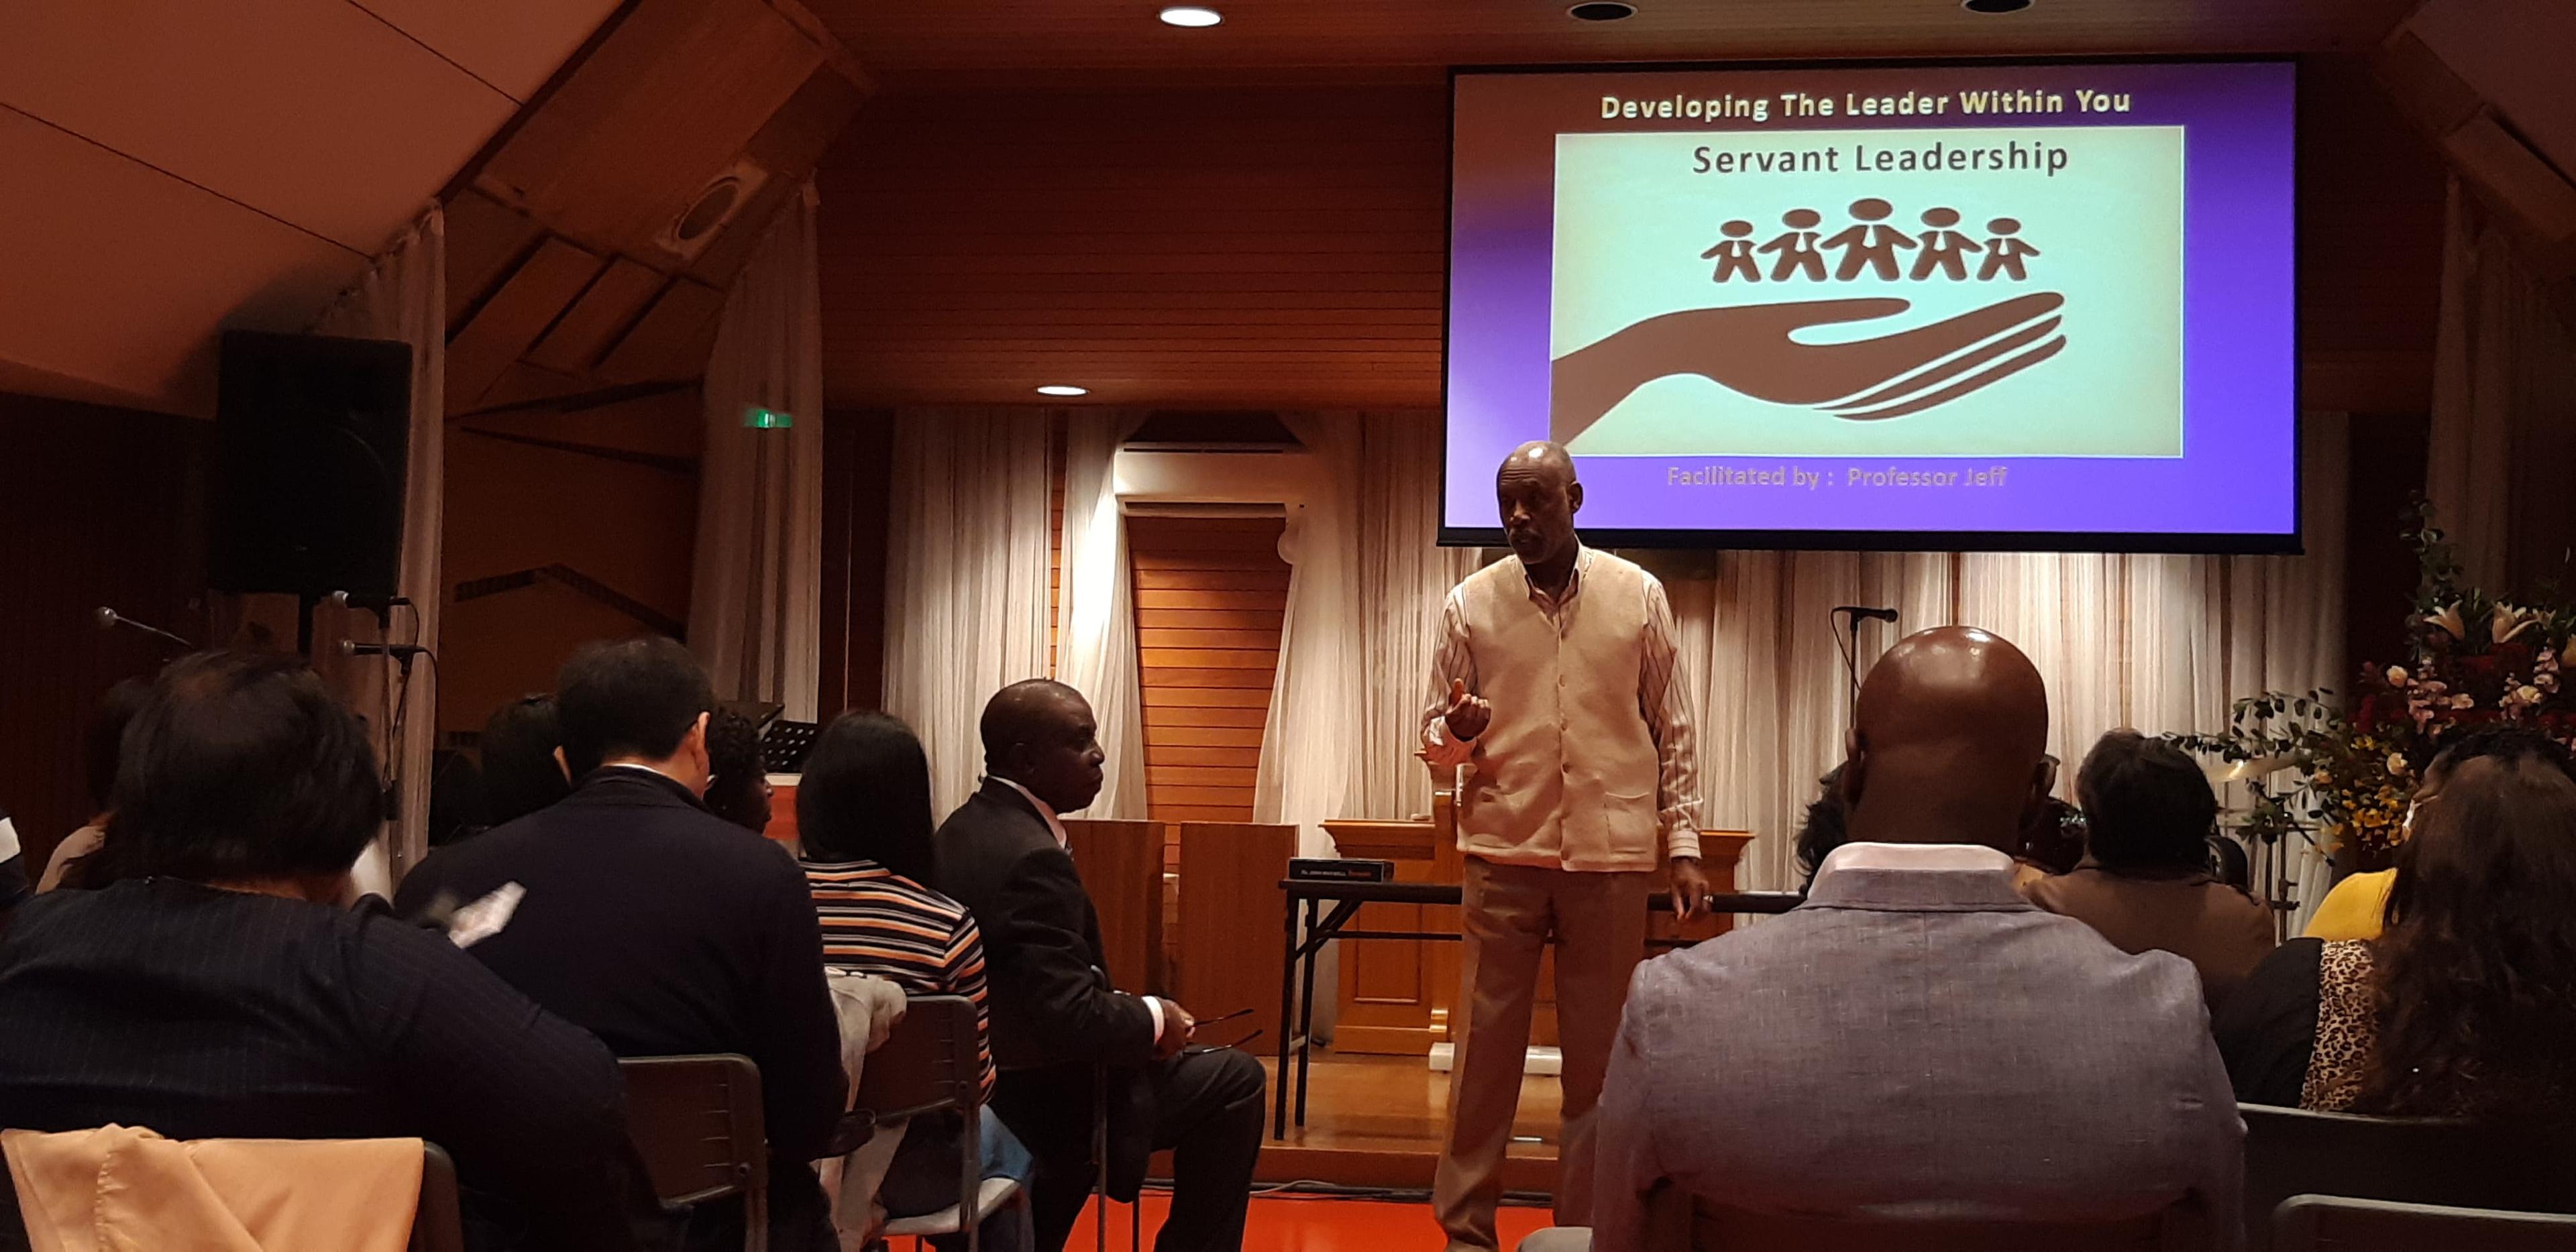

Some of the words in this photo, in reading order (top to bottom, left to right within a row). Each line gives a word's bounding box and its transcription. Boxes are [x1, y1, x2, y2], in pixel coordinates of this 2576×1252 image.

[1601, 93, 1769, 123] Developing
[1780, 93, 1835, 117] The
[1845, 91, 1949, 116] Leader
[1959, 89, 2063, 114] Within
[2075, 89, 2131, 113] You
[1693, 145, 1839, 174] Servant
[1856, 140, 2068, 177] Leadership
[1667, 466, 1785, 486] Facilitated
[1793, 467, 1819, 490] by
[1847, 466, 1957, 486] Professor
[1964, 465, 2008, 486] Jeff
